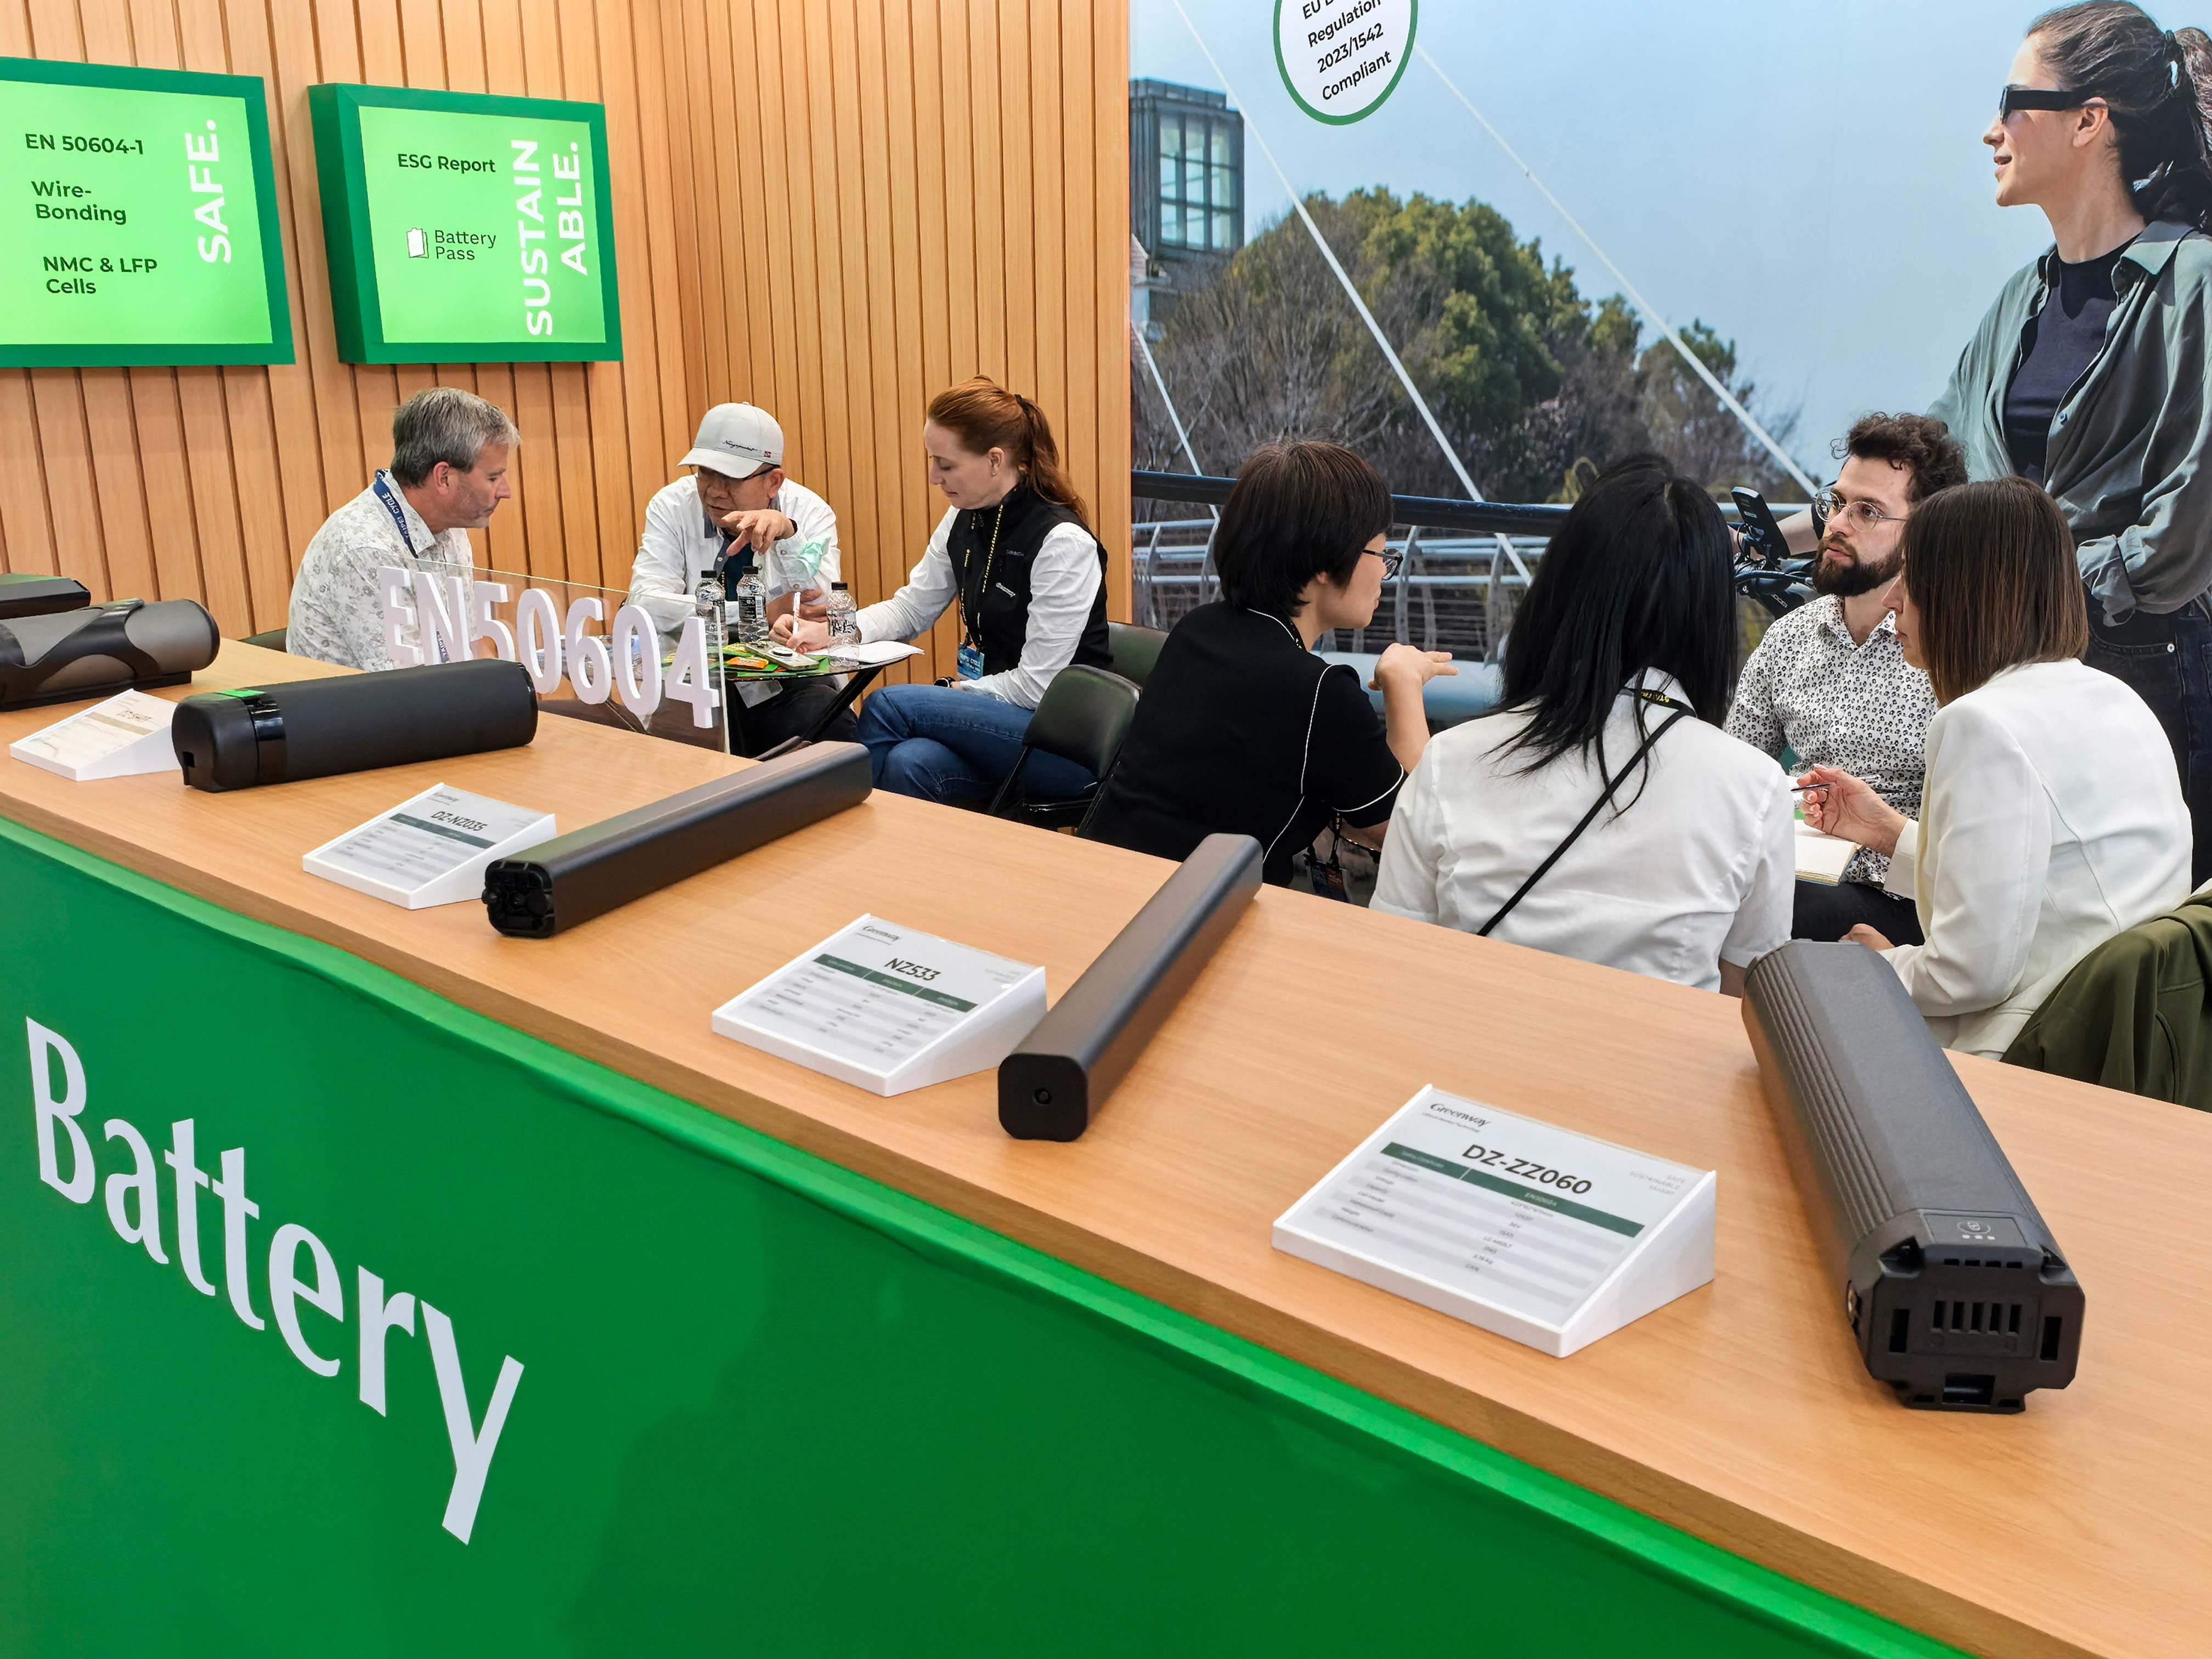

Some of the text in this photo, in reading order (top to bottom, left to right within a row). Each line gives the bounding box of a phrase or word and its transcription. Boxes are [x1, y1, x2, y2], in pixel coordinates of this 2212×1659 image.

[1302, 0, 1321, 19] EU
[1317, 23, 1384, 72] 2023/1542
[1323, 51, 1392, 100] Compliant
[25, 134, 143, 155] EN 50604-1
[398, 154, 495, 173] ESG Report
[31, 181, 92, 198] Wire-
[184, 120, 232, 264] SAFE.
[36, 204, 126, 225] Bonding
[553, 142, 588, 276] ABLE.
[435, 230, 496, 249] Battery
[511, 140, 552, 336] SUSTAIN
[436, 246, 475, 260] Pass
[43, 256, 157, 273] NMC & LFP
[46, 279, 96, 294] Cells
[382, 492, 399, 514] CYCLE
[381, 566, 719, 728] EN50604
[431, 811, 488, 831] DZ-NZ035
[884, 958, 941, 981] NZ533
[1430, 1103, 1492, 1127] Greenway
[1462, 1144, 1592, 1196] DZ-ZZ060
[26, 1017, 524, 1545] Battery
